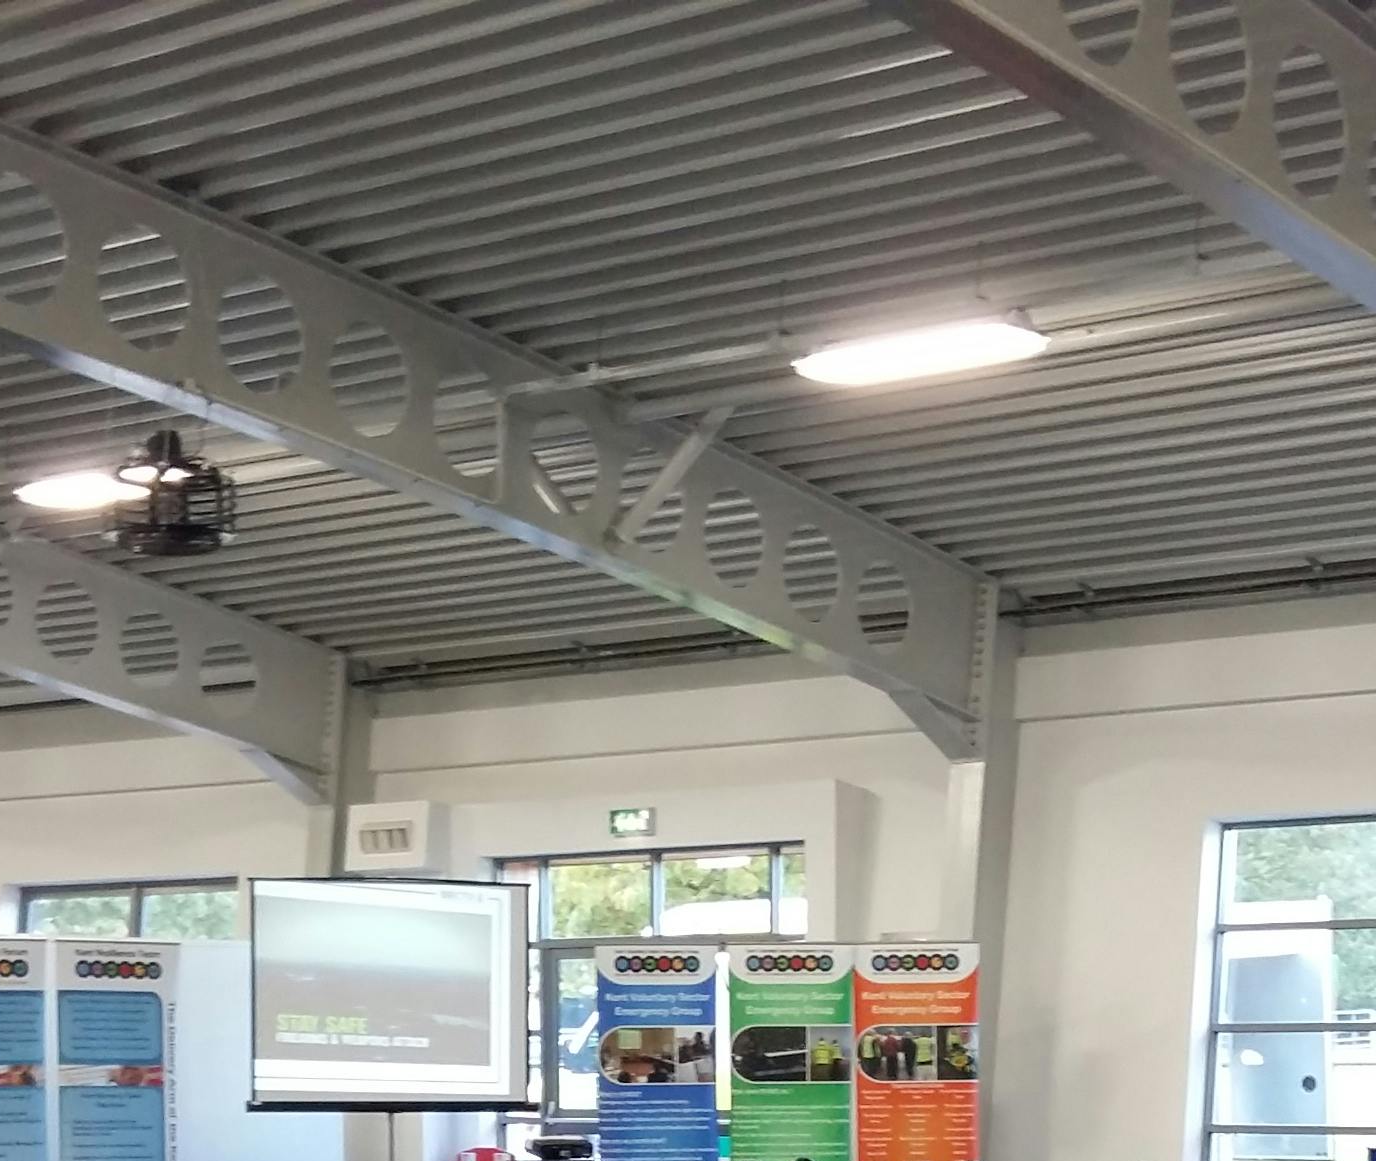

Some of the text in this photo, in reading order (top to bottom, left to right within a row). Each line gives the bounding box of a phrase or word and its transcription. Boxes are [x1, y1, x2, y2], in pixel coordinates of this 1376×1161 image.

[605, 993, 711, 1003] Kent Voluntary Sector
[861, 991, 886, 1001] Kent
[935, 990, 970, 1000] Sector
[614, 1006, 703, 1017] Emergency Group
[804, 1005, 835, 1015] Group
[871, 1004, 962, 1016] Emergency Group
[325, 1016, 369, 1034] SAFE
